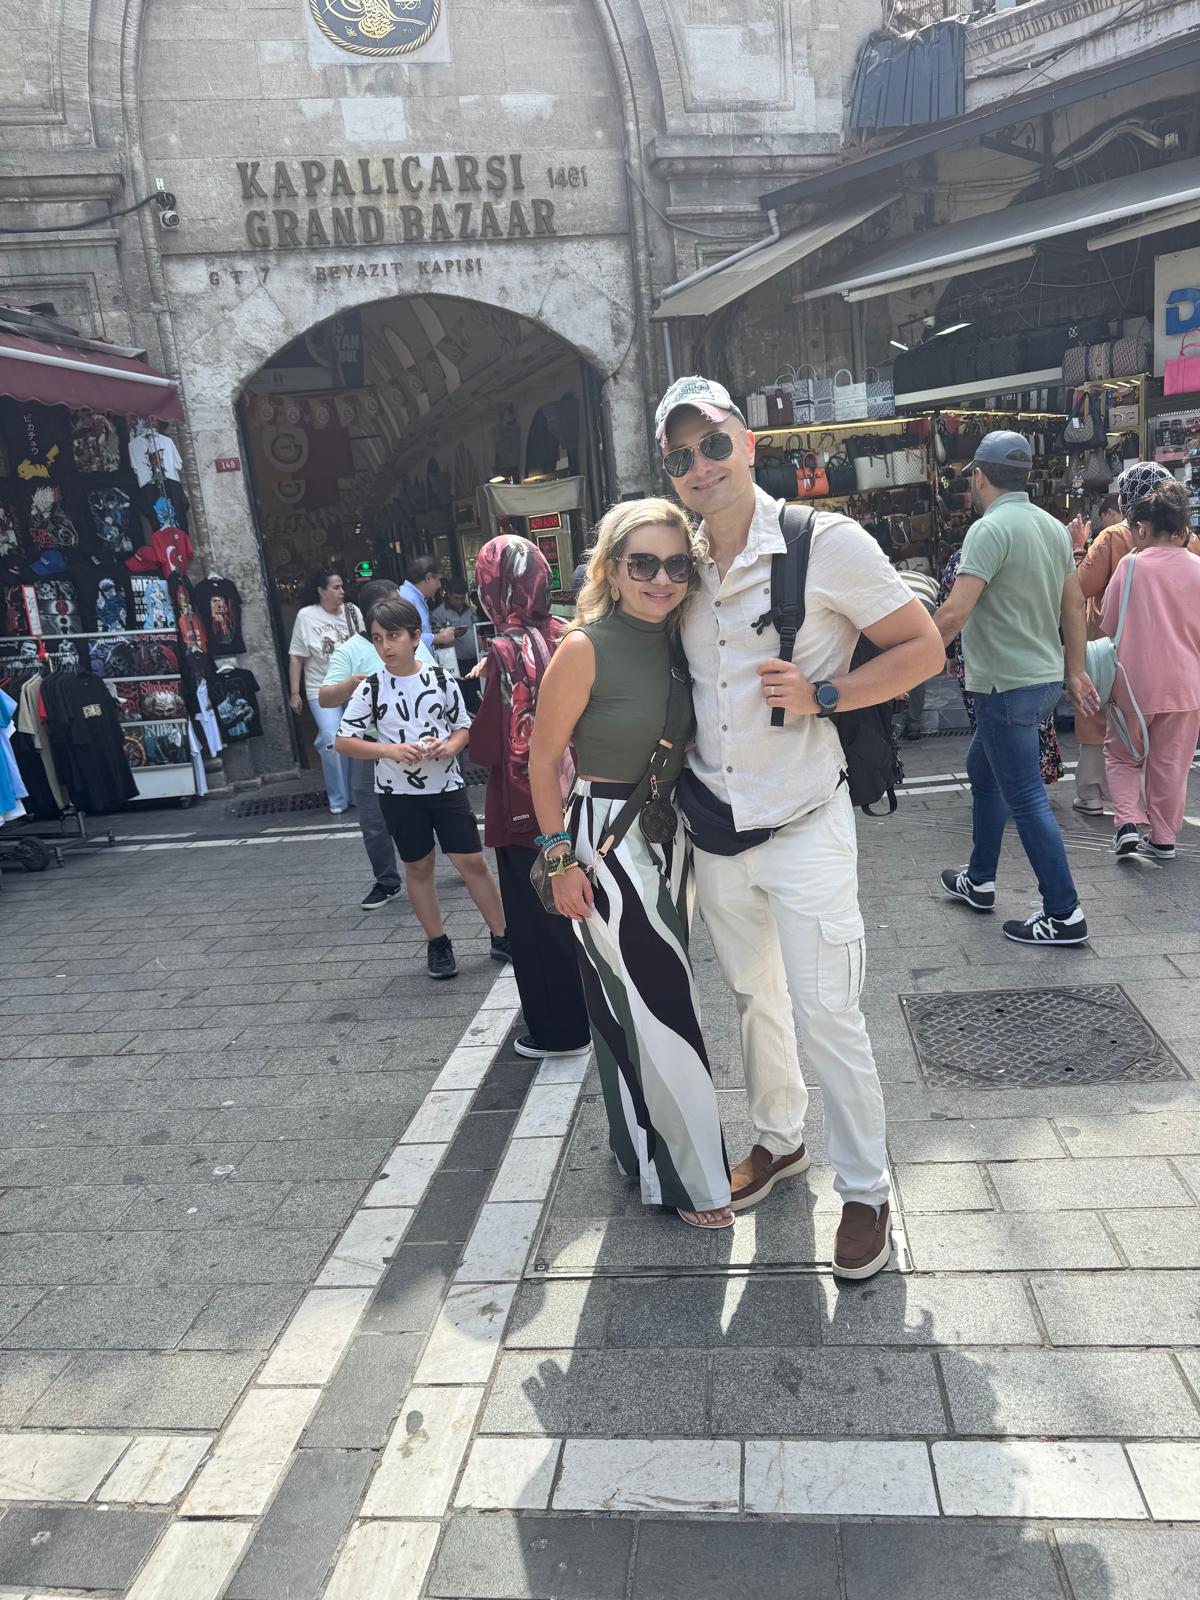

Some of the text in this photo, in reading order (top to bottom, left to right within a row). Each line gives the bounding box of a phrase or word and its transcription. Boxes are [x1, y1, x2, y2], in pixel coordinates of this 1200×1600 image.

[548, 165, 588, 188] 1461
[246, 199, 557, 248] GRAND BAZAAR
[230, 270, 243, 284] T
[315, 257, 482, 282] BEYAZIT KAPISI
[1032, 917, 1059, 940] AX
